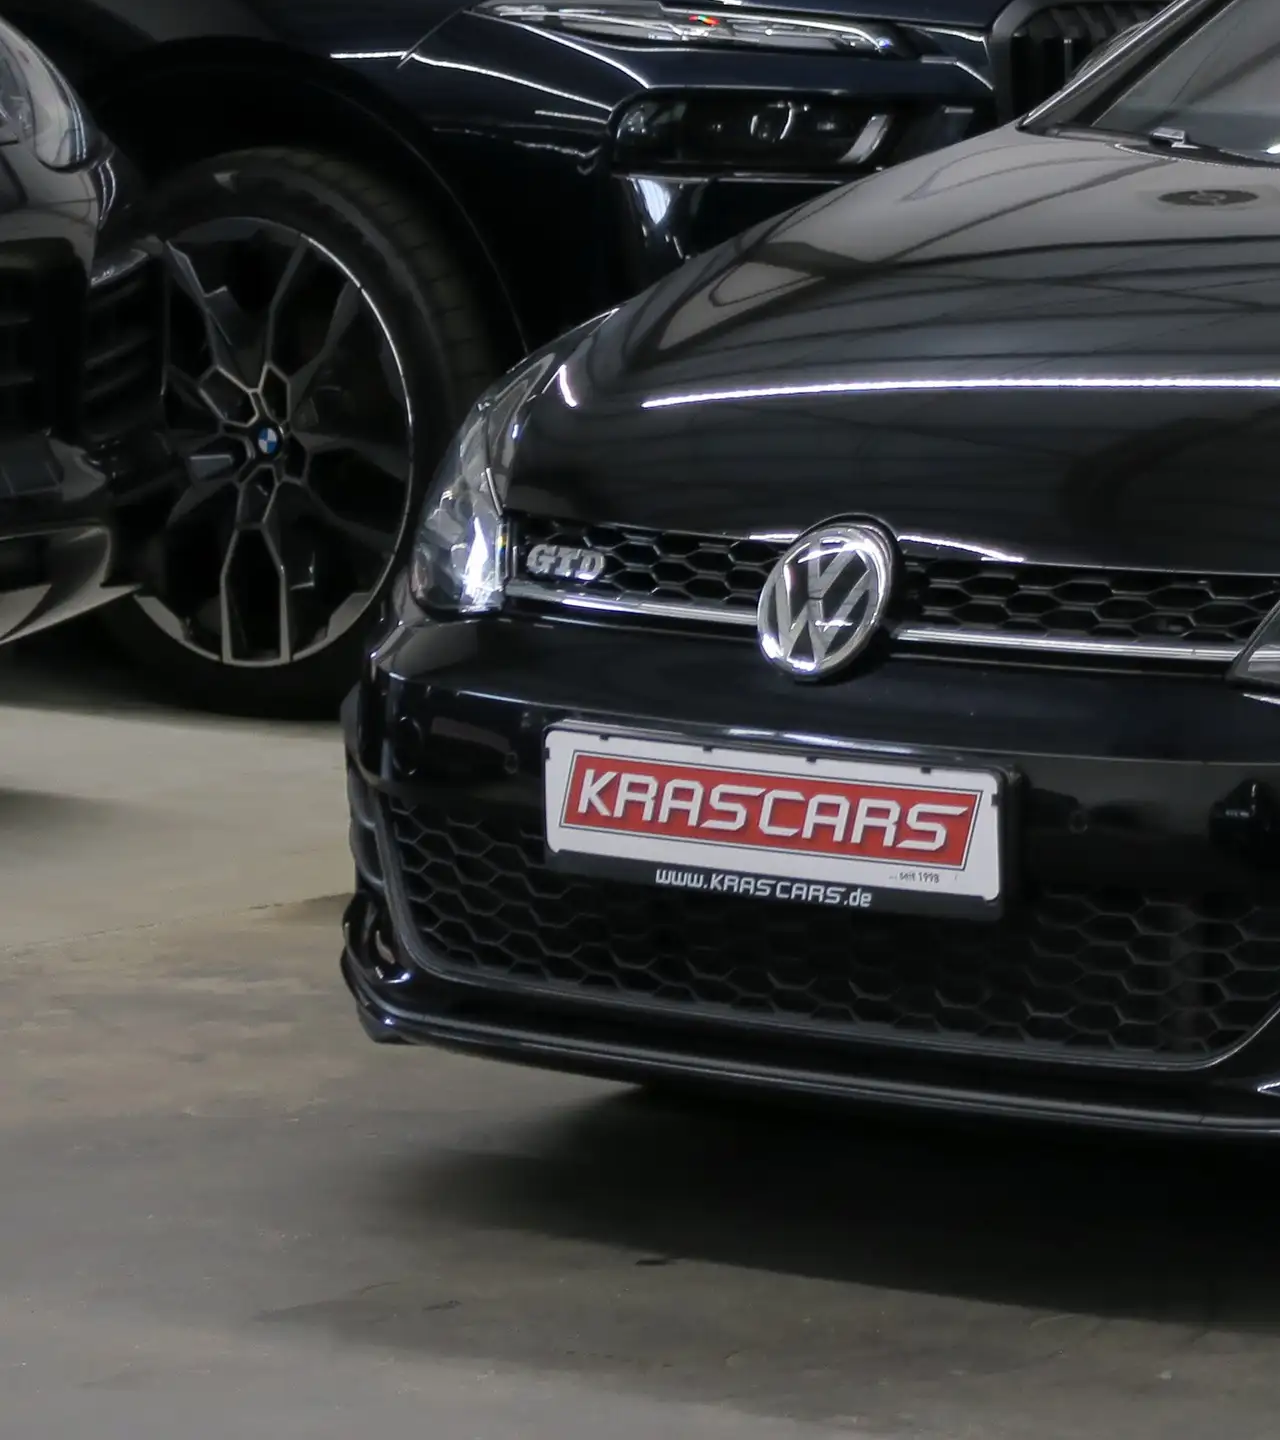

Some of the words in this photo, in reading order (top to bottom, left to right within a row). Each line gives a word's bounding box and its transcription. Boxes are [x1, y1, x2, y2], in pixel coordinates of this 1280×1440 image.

[527, 543, 605, 581] GTD
[576, 768, 968, 851] KRASCARS
[655, 867, 873, 908] www.KRASCARS.de
